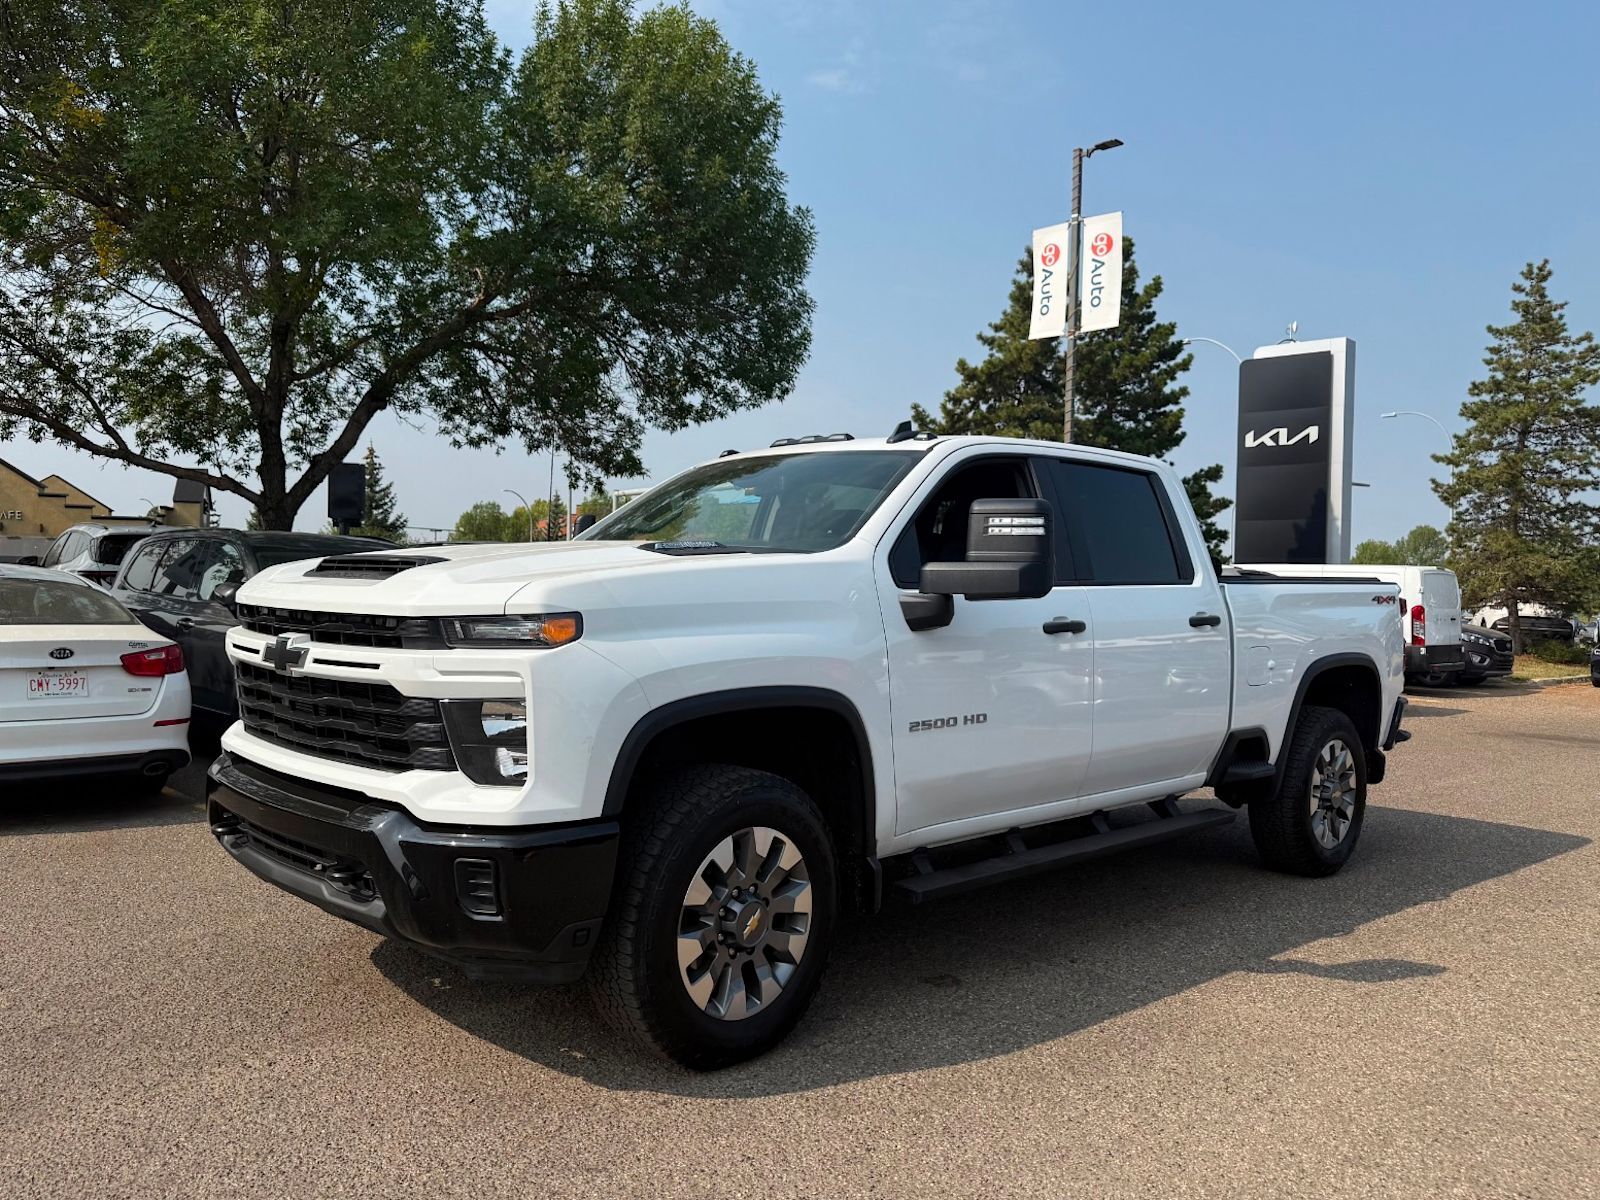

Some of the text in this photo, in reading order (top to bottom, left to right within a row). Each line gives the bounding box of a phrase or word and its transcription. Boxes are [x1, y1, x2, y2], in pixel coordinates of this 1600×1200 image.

[1040, 243, 1060, 316] go Auto
[1090, 232, 1114, 308] go Auto
[1244, 425, 1319, 448] KIA
[52, 649, 71, 658] KIA
[908, 713, 988, 733] 2500 HD
